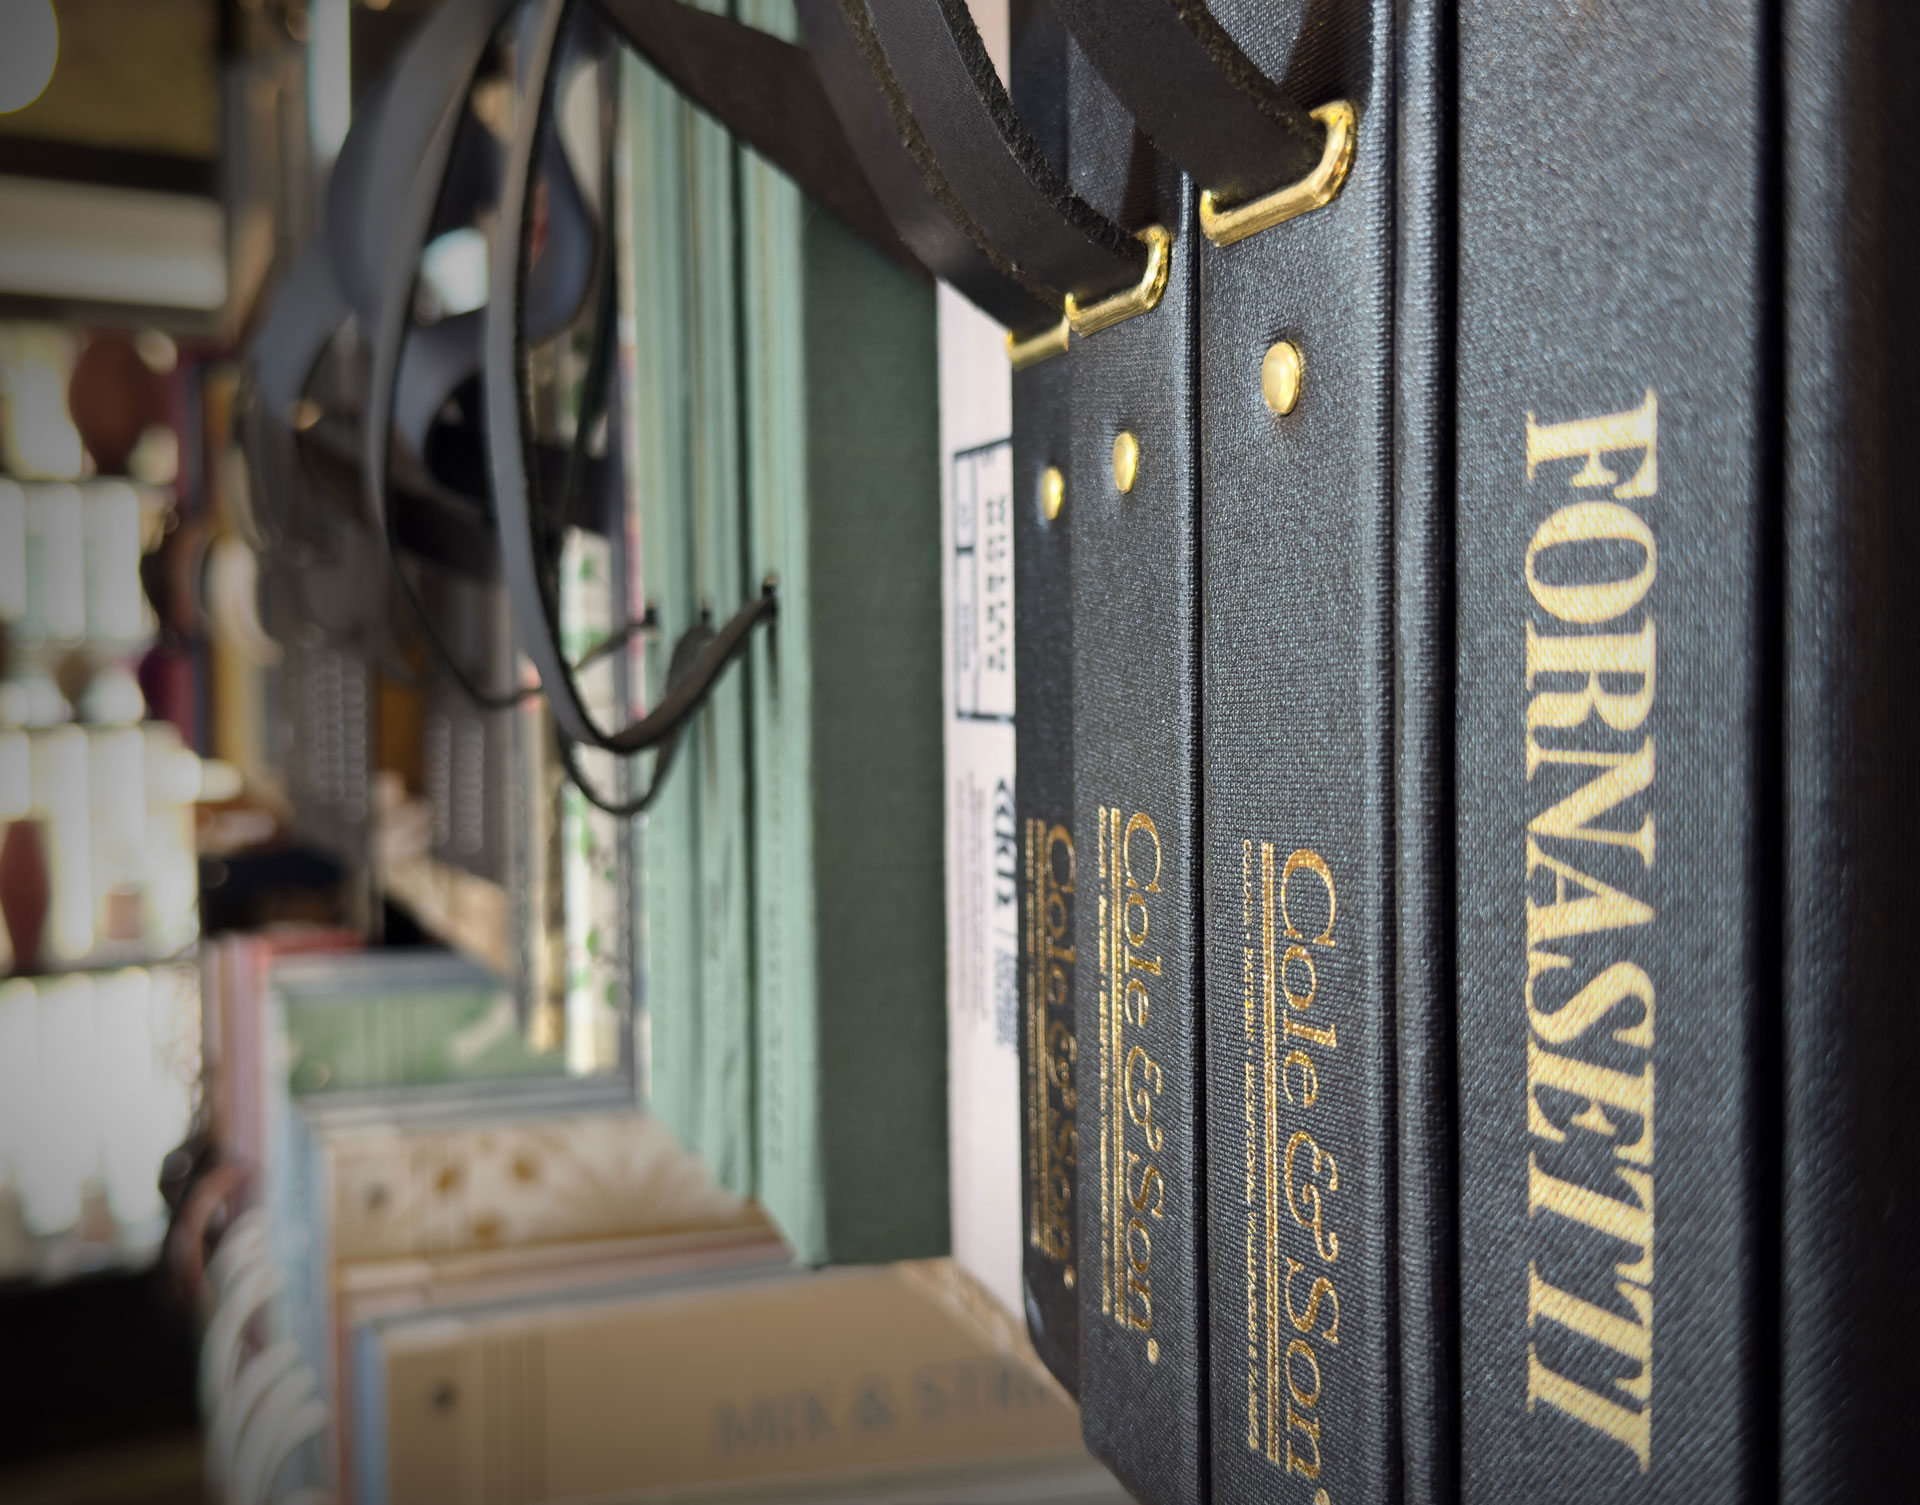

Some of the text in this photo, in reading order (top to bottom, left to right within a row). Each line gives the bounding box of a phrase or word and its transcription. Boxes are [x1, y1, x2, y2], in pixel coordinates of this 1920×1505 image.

[1047, 824, 1077, 1006] Cole
[1123, 812, 1162, 1027] Cole
[1281, 848, 1338, 1109] Cole
[1525, 388, 1658, 1472] FORNASETTI
[1124, 1045, 1163, 1151] &
[1286, 1130, 1339, 1263] &
